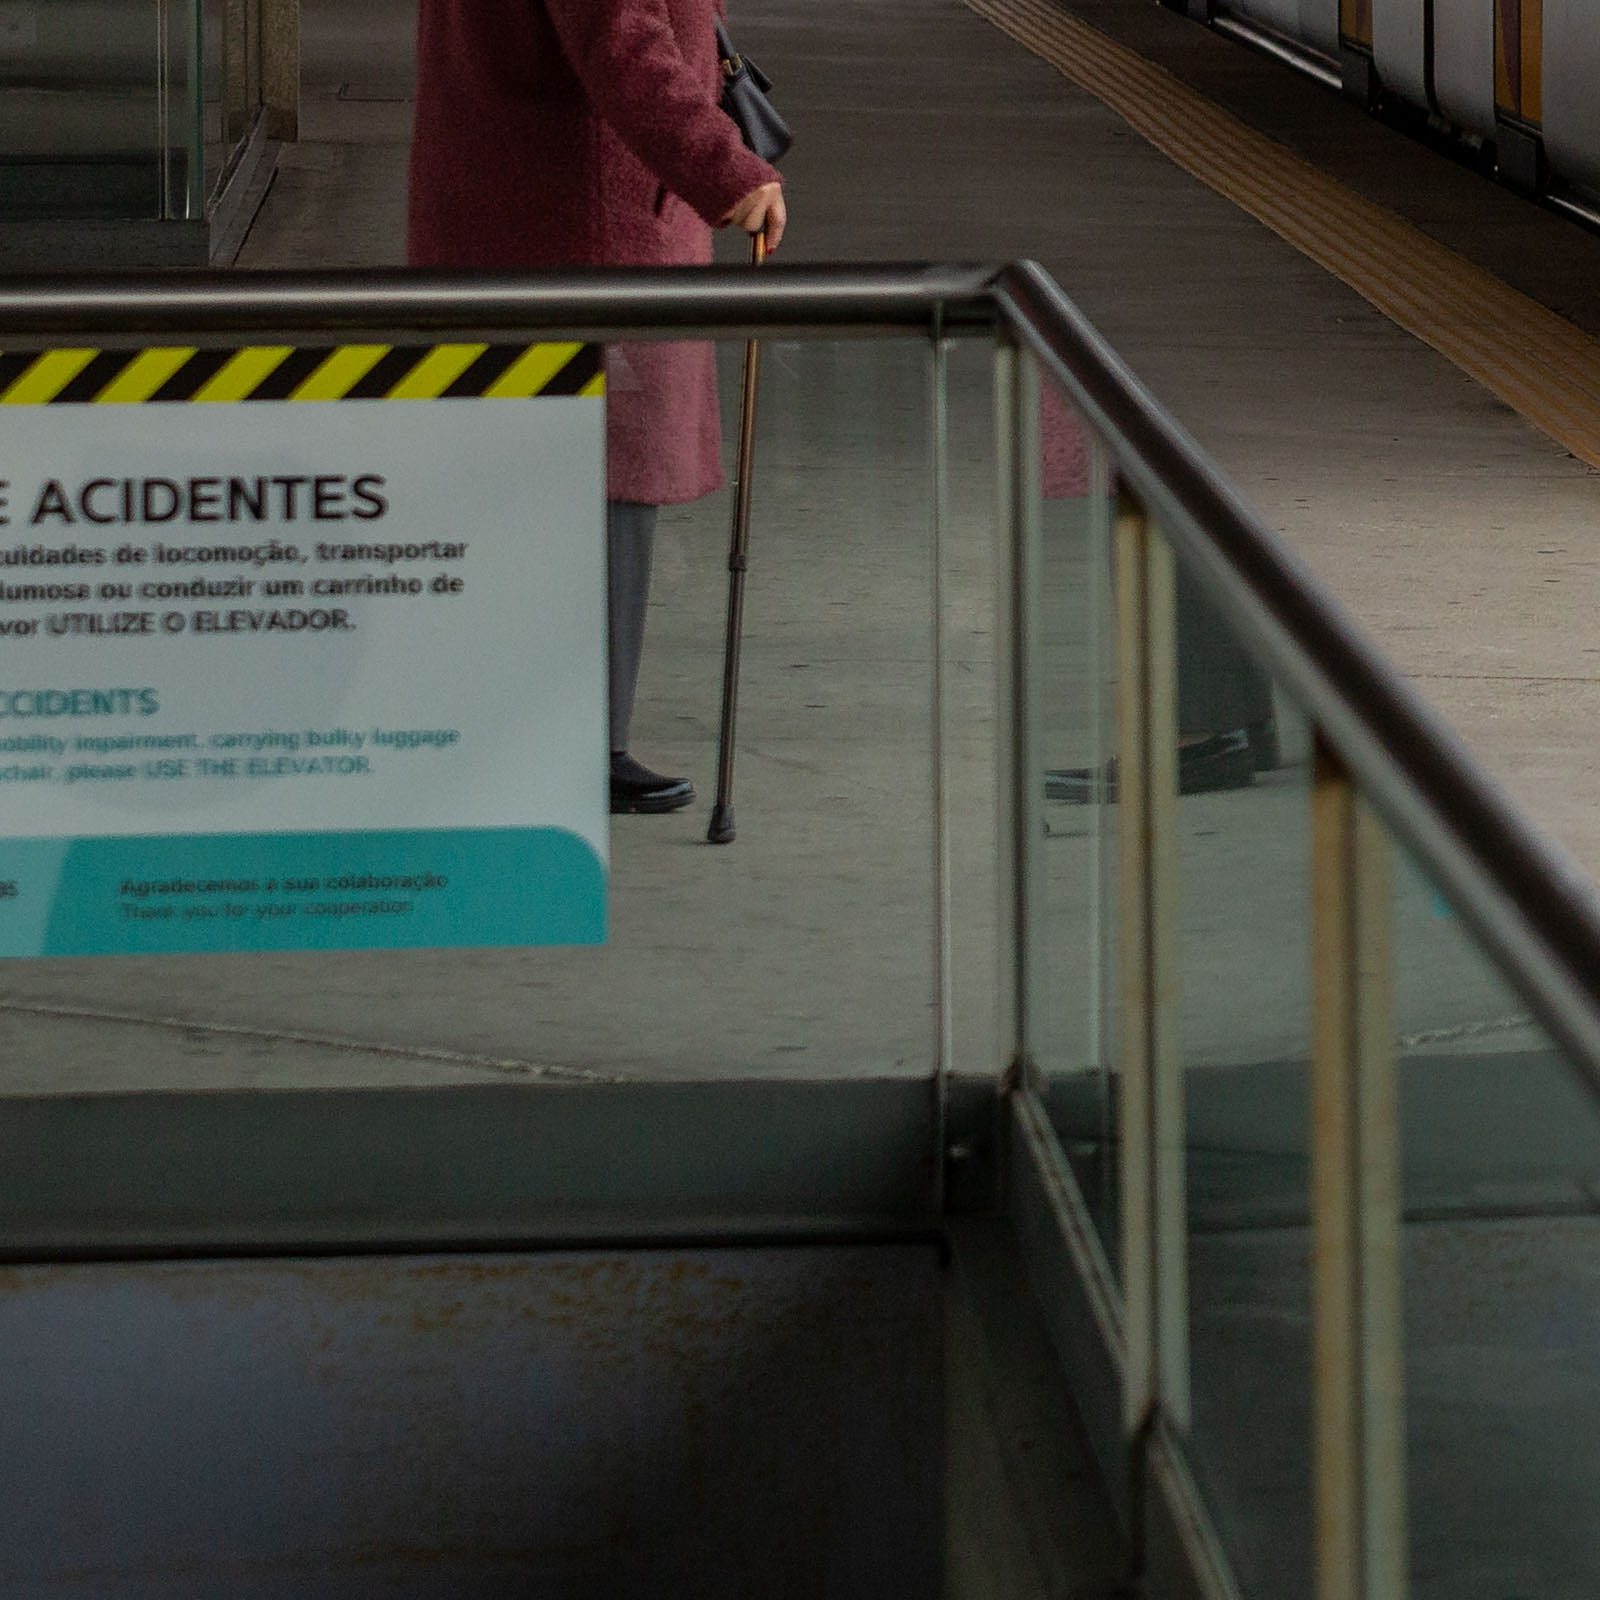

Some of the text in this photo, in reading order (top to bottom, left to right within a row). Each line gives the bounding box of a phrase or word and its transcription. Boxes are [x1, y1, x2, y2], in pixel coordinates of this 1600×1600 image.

[31, 473, 390, 525] ACIDENTES
[114, 543, 148, 566] de
[154, 539, 308, 568] locomoção,
[317, 540, 469, 566] transportar
[99, 582, 133, 600] ou
[140, 576, 253, 599] conduzir
[262, 579, 304, 597] um
[312, 573, 422, 596] carrinho
[430, 573, 465, 595] de
[47, 611, 156, 635] UTILIZE
[163, 610, 187, 634] O
[193, 608, 357, 633] ELEVADOR.
[210, 730, 300, 752] carrying
[372, 726, 461, 750] luggage
[119, 879, 259, 902] Agradecemos
[283, 876, 319, 892] sua
[326, 871, 449, 894] colaboração
